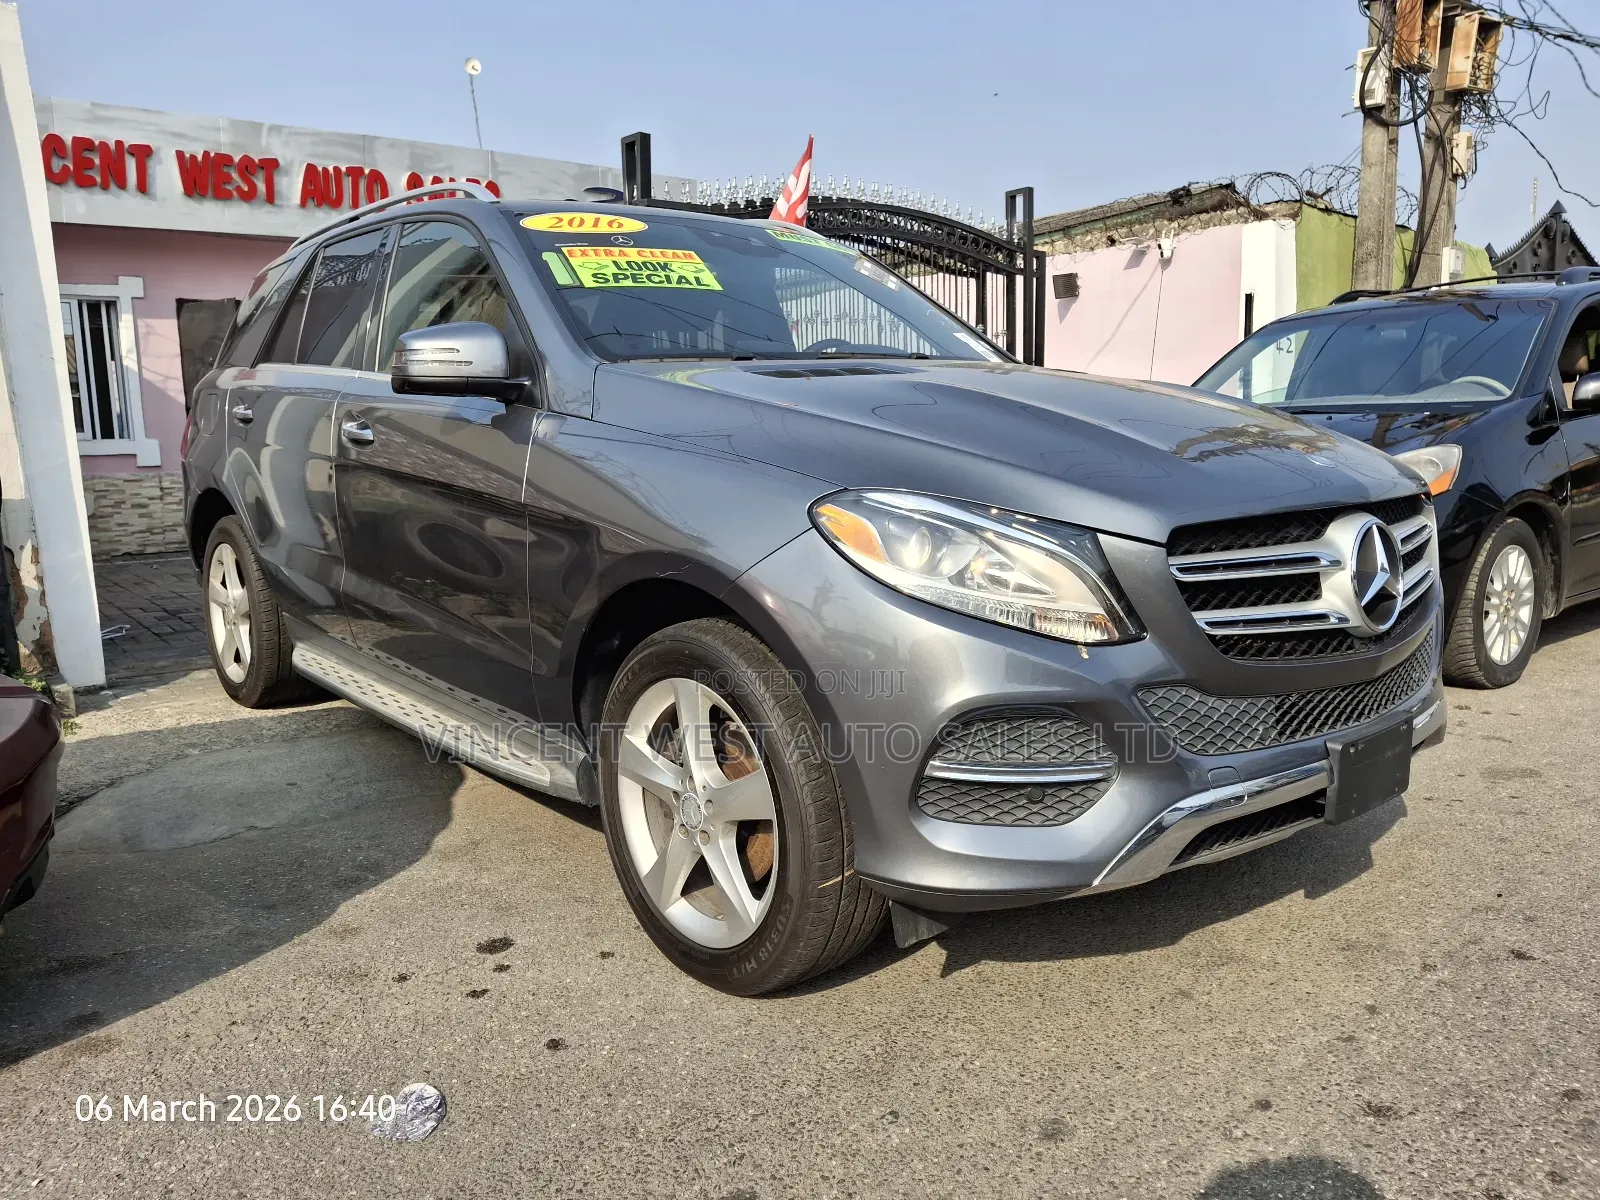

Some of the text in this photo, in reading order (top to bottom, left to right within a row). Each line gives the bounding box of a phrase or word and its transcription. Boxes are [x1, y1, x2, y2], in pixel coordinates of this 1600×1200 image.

[41, 133, 501, 210] CENT WEST AUTO SAS
[547, 216, 625, 229] 2016
[566, 248, 696, 261] EXTRA CLEAN
[611, 259, 674, 274] LOOK
[591, 271, 711, 288] SPECIAL
